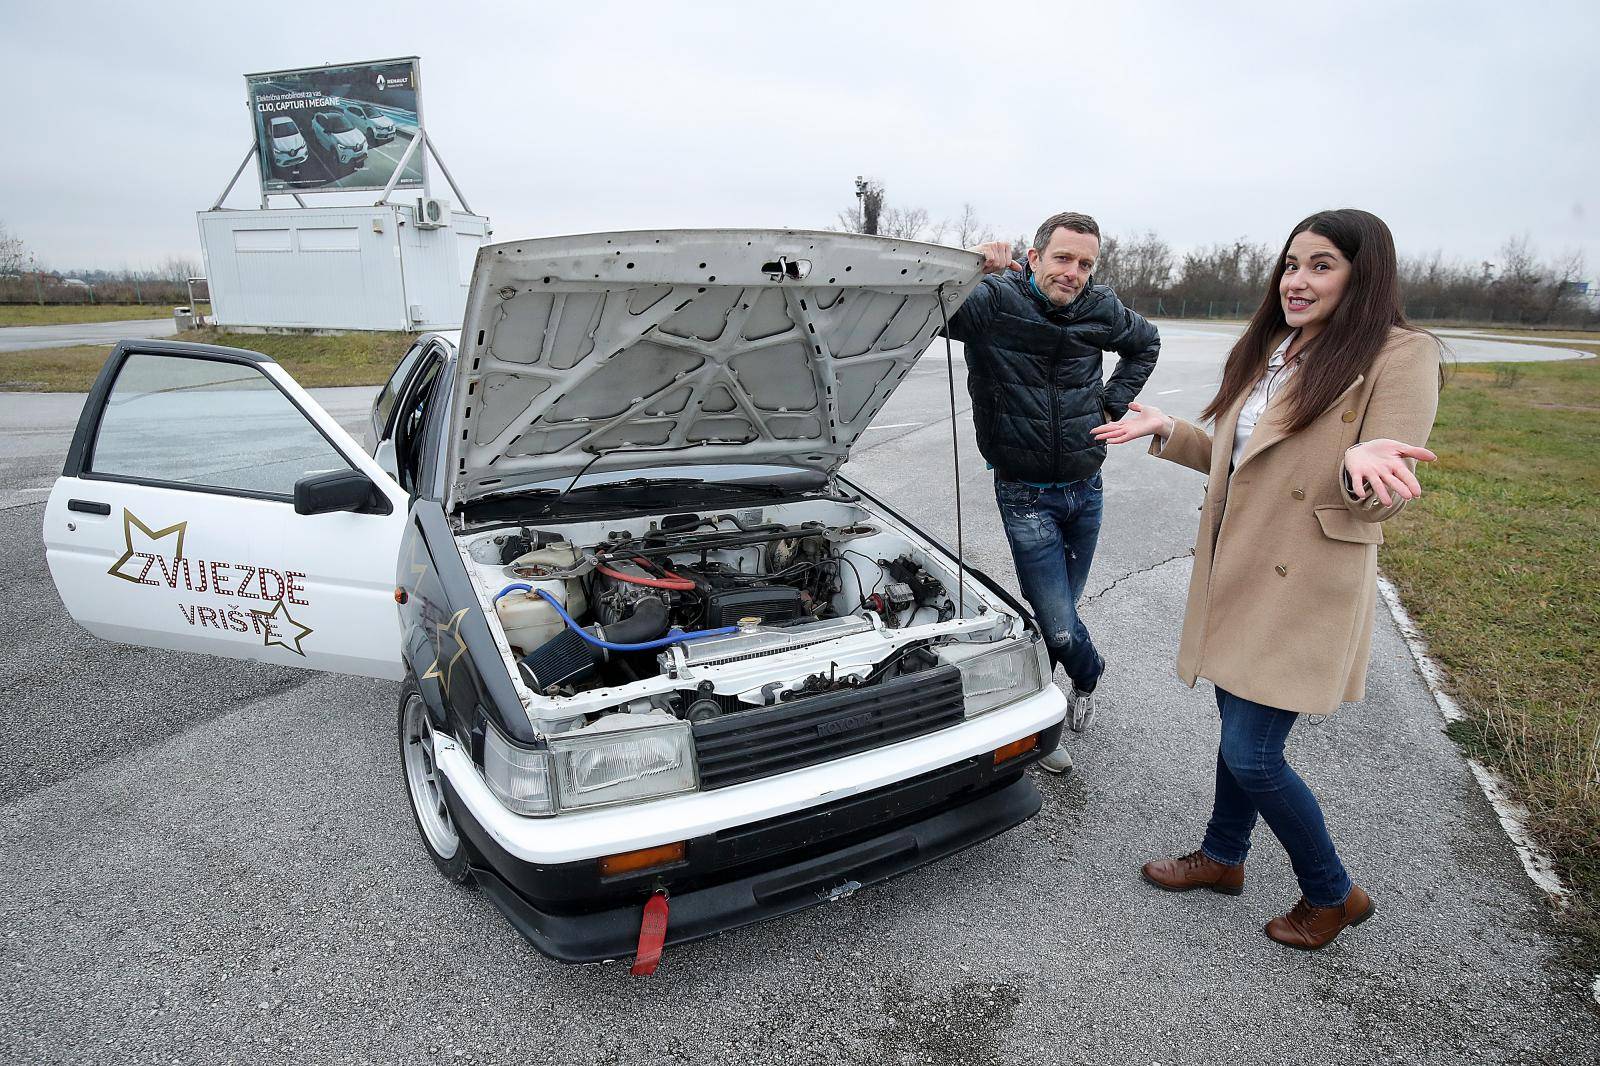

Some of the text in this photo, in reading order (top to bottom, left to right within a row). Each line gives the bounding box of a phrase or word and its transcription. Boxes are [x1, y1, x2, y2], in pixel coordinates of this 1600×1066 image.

[257, 103, 276, 112] CLIO,
[276, 100, 305, 111] CAPTUR
[135, 552, 309, 605] ZVIJEZDE
[178, 603, 283, 638] VRIŠTE
